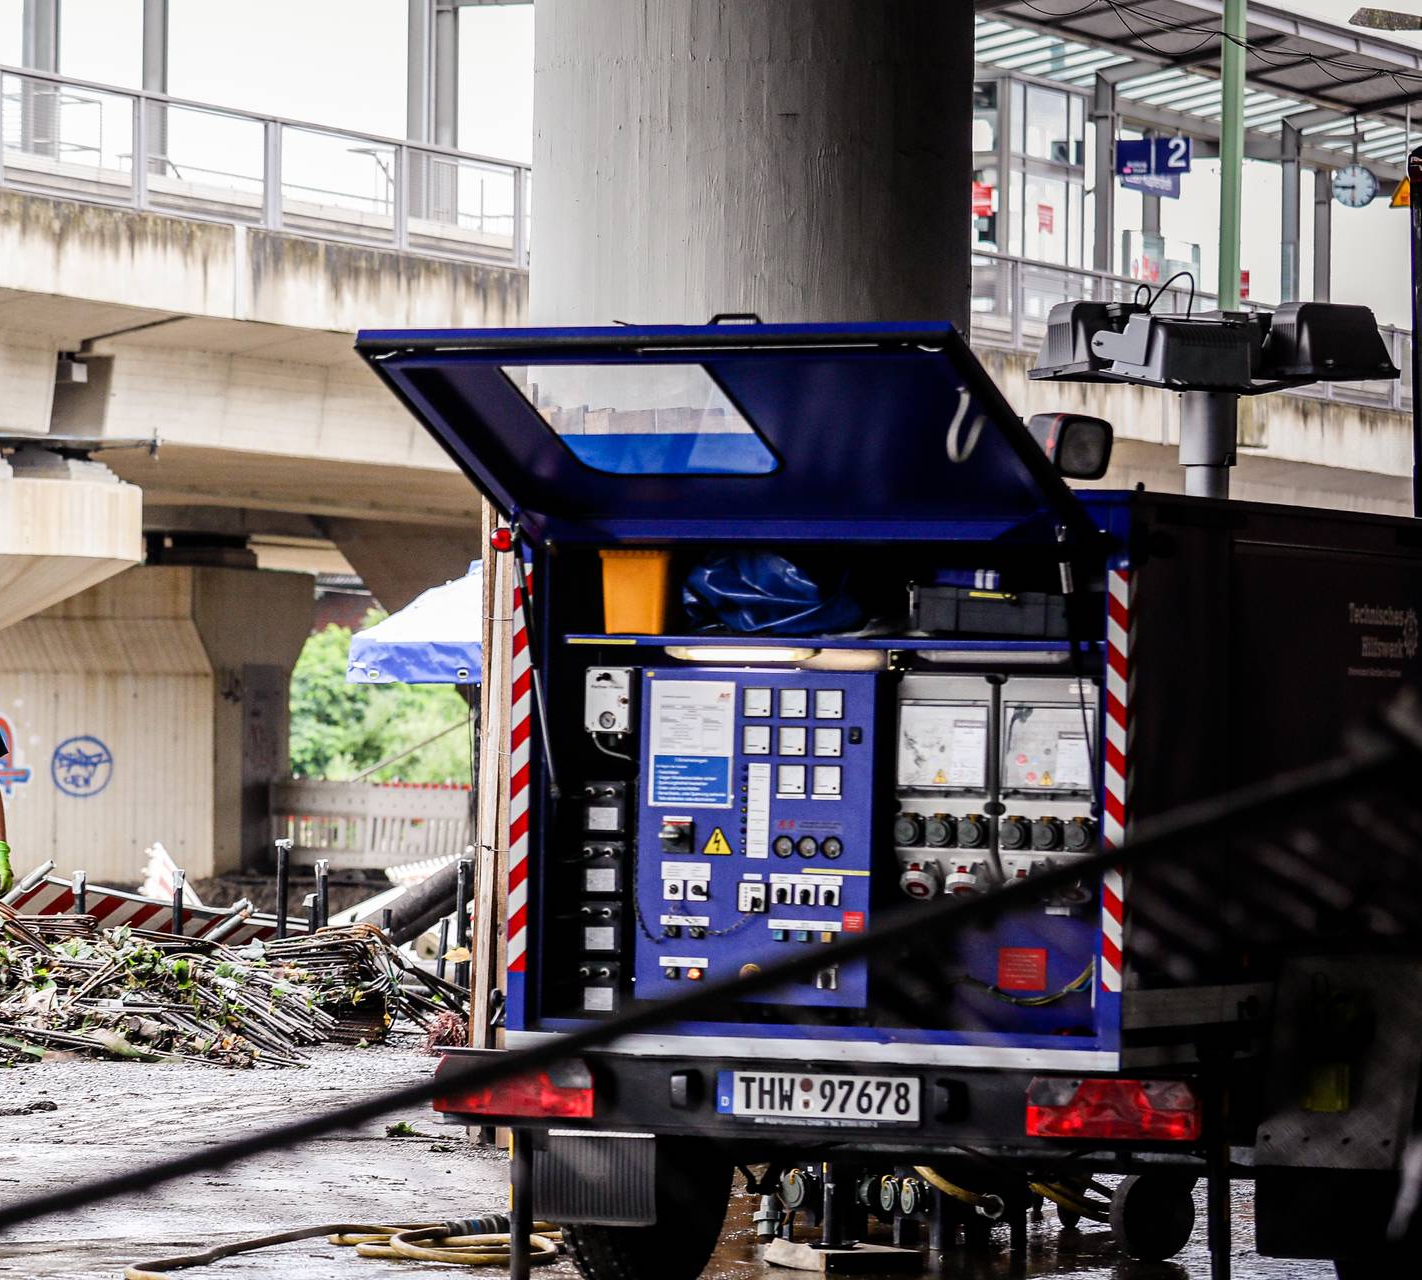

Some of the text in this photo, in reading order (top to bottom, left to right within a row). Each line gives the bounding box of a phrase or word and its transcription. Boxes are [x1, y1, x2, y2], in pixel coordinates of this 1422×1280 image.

[1168, 138, 1186, 167] 2
[739, 1077, 911, 1115] THW 97678
